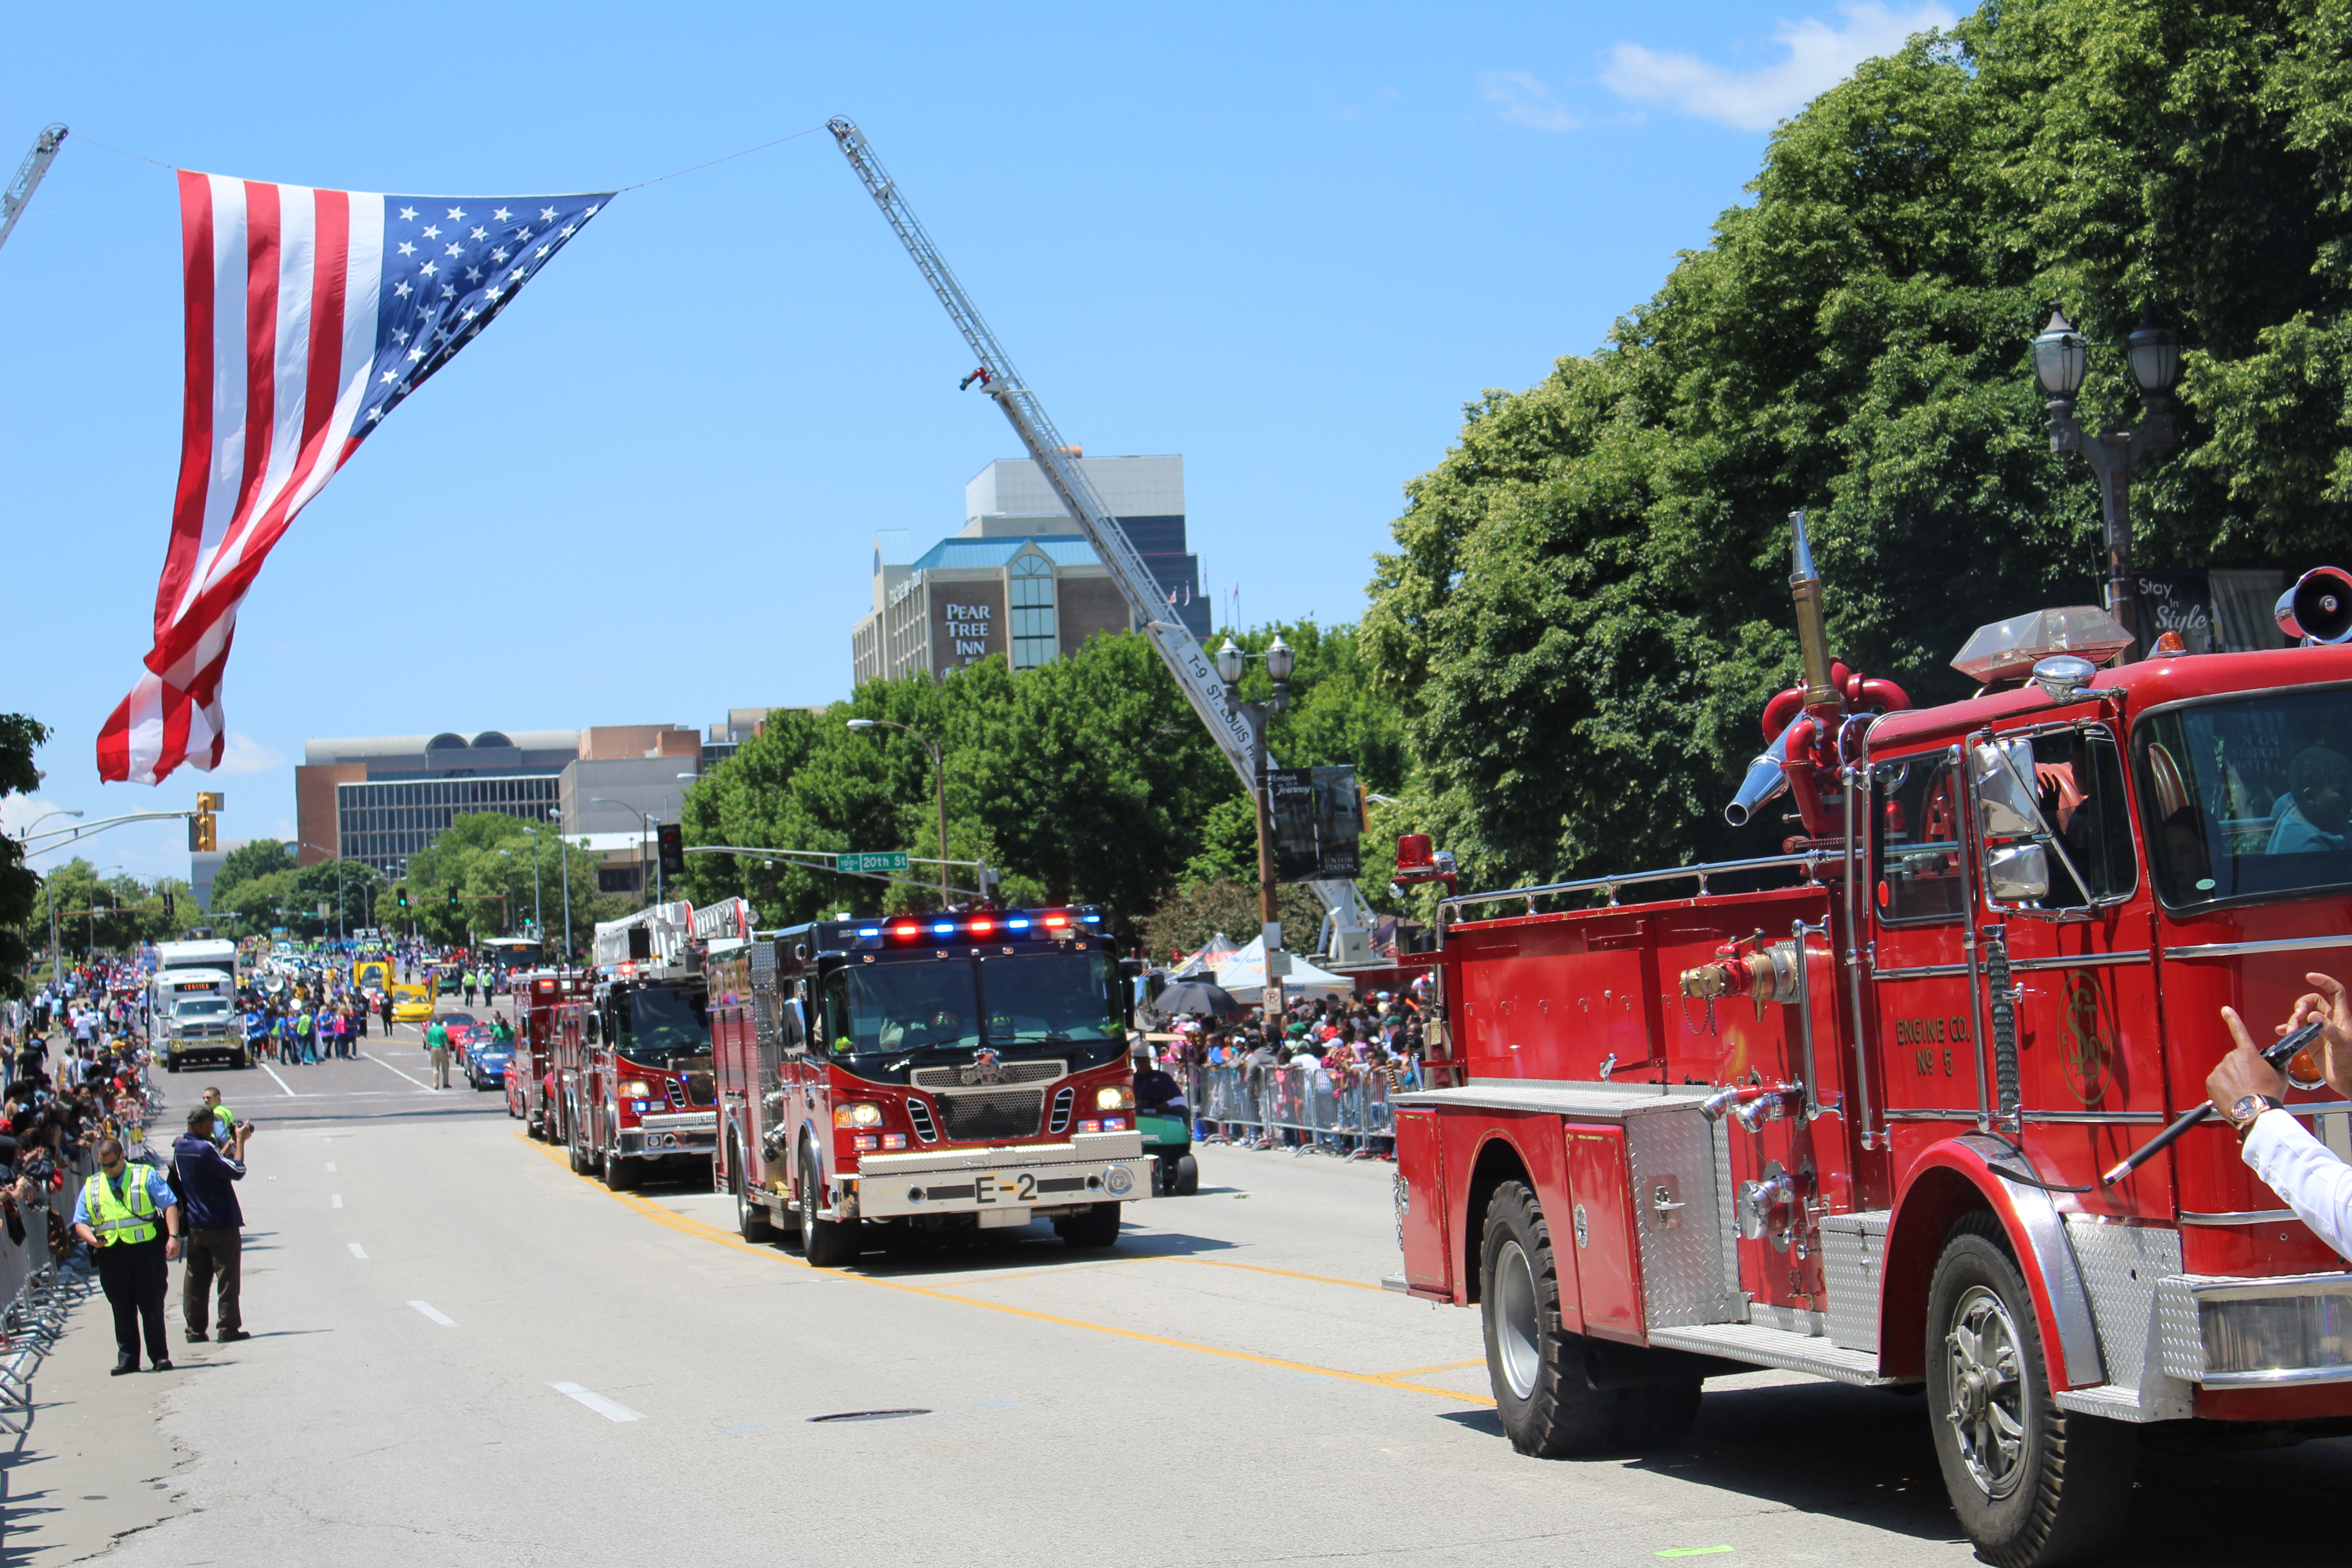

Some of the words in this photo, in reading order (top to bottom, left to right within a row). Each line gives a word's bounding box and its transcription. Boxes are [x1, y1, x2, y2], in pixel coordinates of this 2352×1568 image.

[2139, 578, 2172, 599] Stay
[946, 603, 991, 620] PEAR
[2170, 598, 2179, 608] In
[946, 621, 989, 637] TREE
[2156, 605, 2207, 634] Style
[956, 639, 985, 655] INN
[1188, 654, 1207, 678] T-9
[1276, 784, 1311, 796] Journey
[863, 857, 889, 867] 20th
[894, 856, 906, 866] St
[1896, 1018, 1945, 1045] ENGINE
[1950, 1015, 1970, 1043] CO.
[1944, 1048, 1953, 1077] 5
[975, 1173, 1037, 1204] E-2
